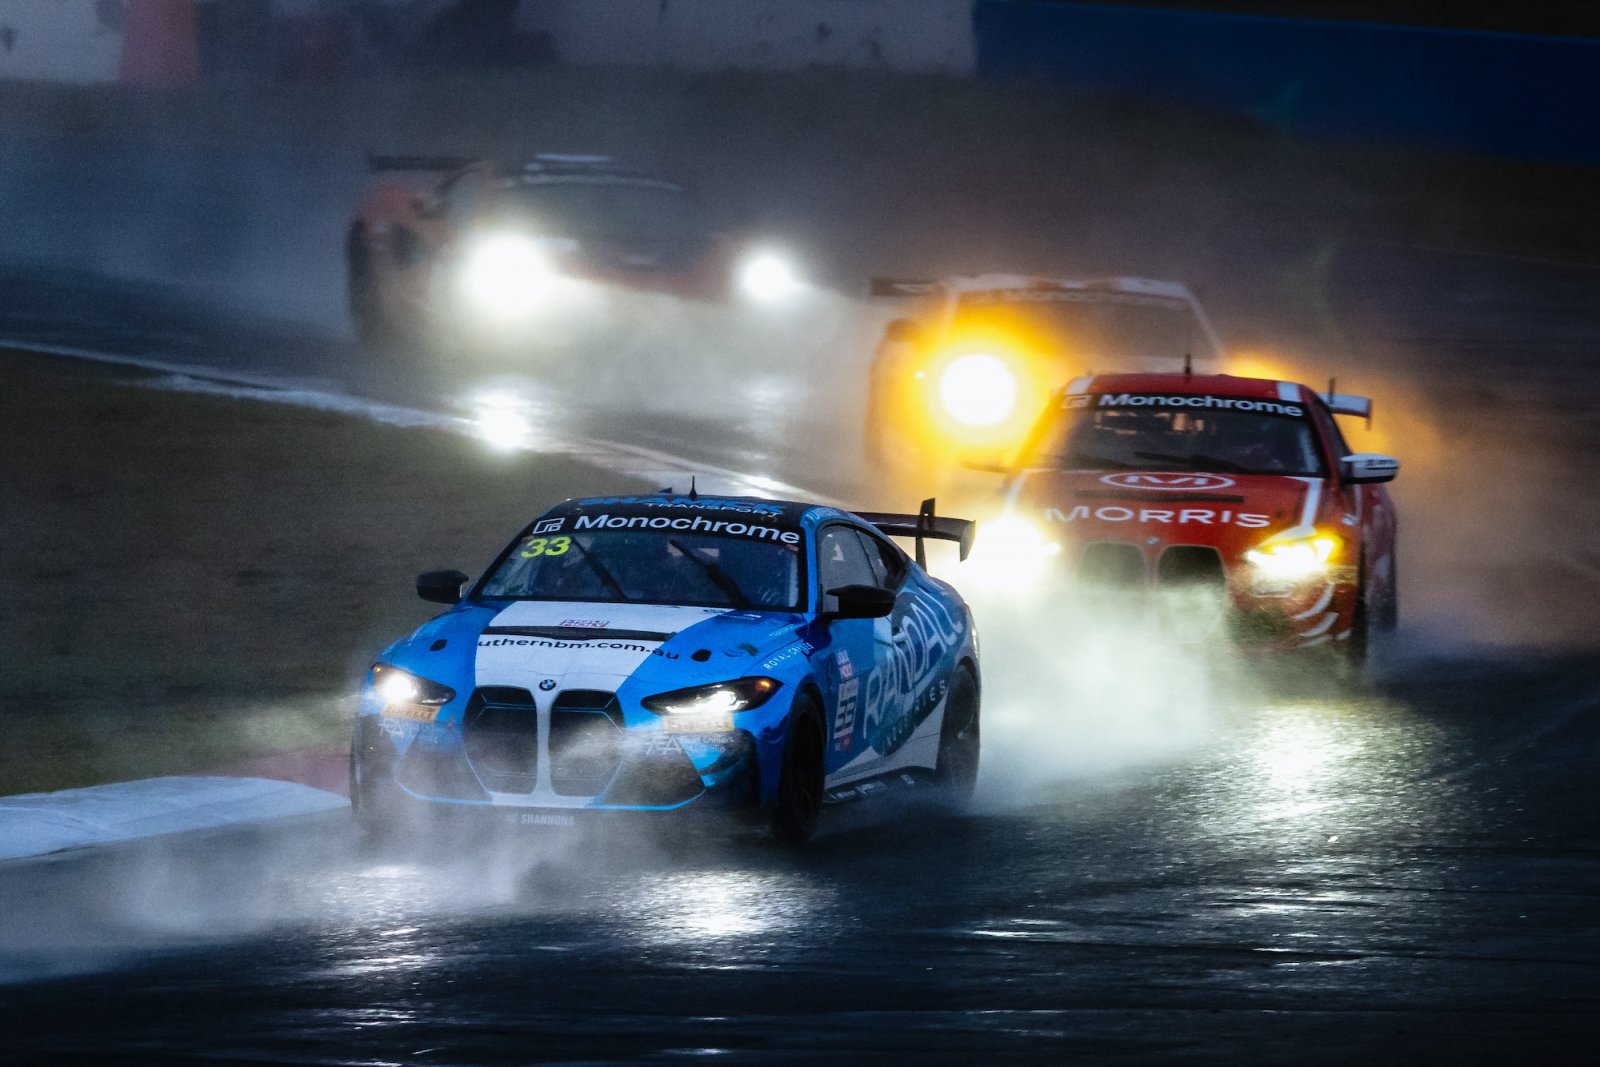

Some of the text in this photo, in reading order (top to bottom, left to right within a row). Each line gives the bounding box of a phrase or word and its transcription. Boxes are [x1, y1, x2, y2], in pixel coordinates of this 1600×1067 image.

[1100, 394, 1304, 417] Monochrome
[648, 503, 784, 518] TRANSPORT
[1045, 505, 1271, 528] MORRIS
[574, 514, 800, 544] Monochrome
[520, 536, 571, 558] 33
[520, 813, 575, 826] SHANNONS
